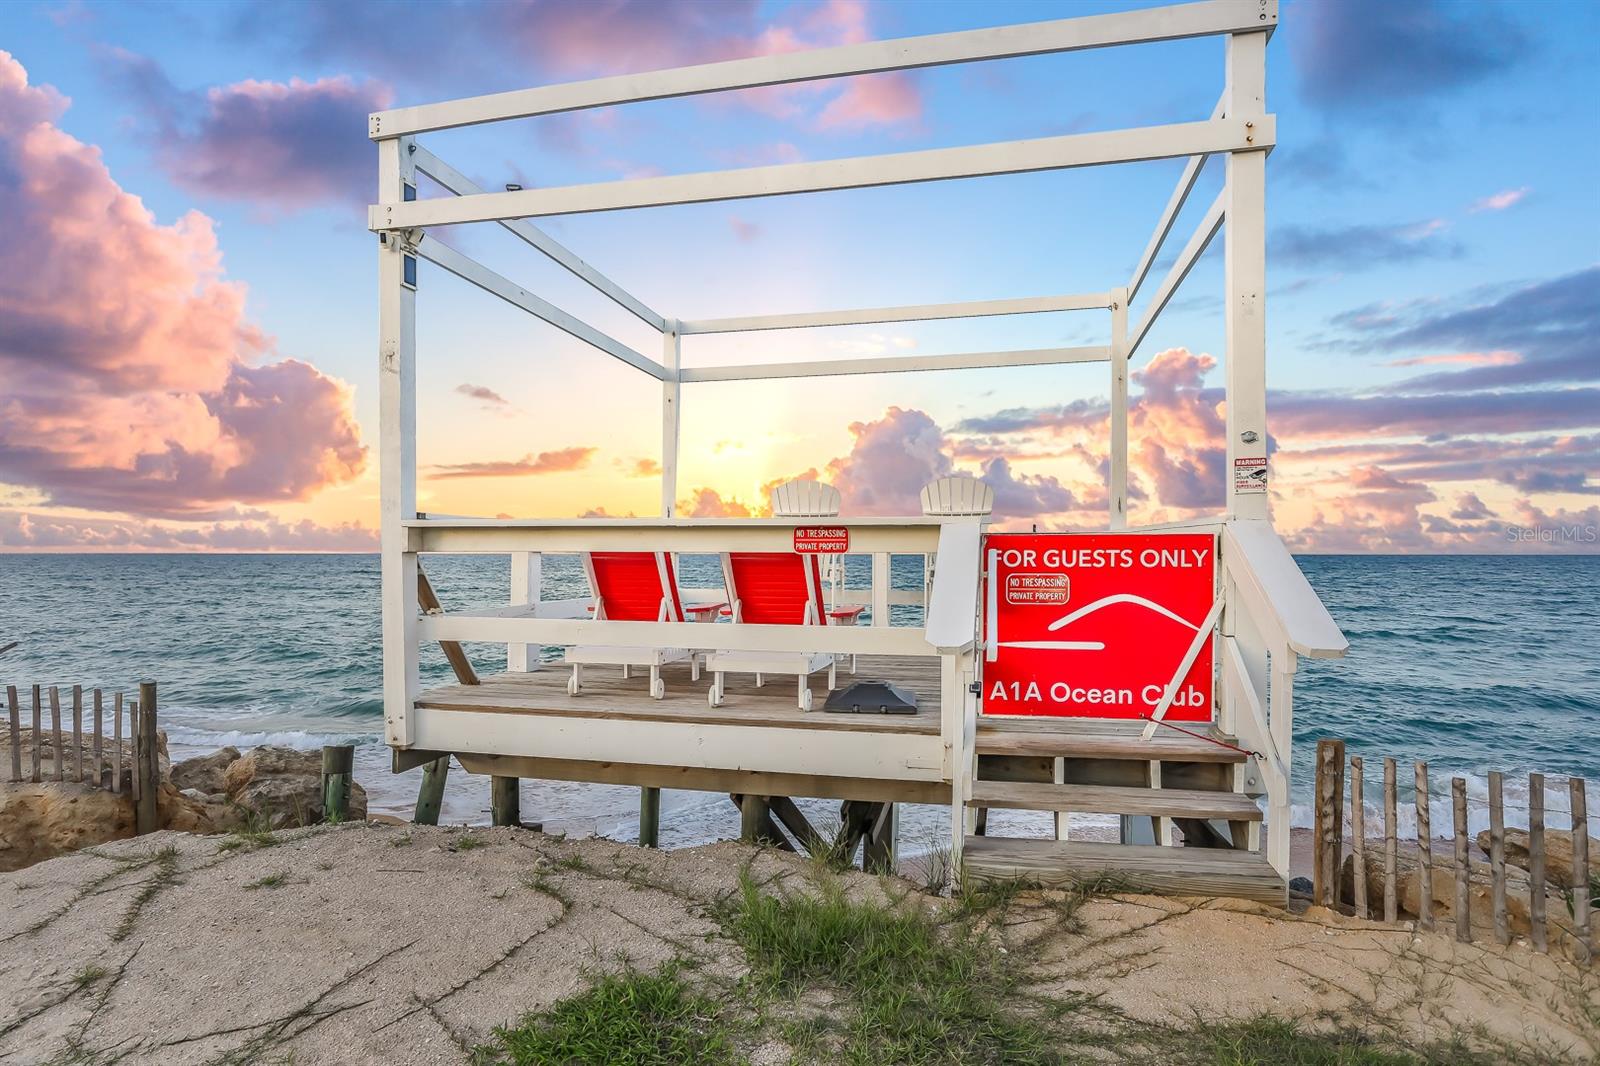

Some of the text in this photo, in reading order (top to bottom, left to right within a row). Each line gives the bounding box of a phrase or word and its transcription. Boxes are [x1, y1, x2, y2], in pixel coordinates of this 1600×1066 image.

[1043, 549, 1133, 567] GUESTS
[1140, 549, 1209, 568] ONLY
[1010, 578, 1066, 587] NO TRESPASSING
[1010, 592, 1066, 600] PRIVATE PROPERTY
[990, 681, 1042, 702] A1A
[1050, 682, 1133, 705] Ocean
